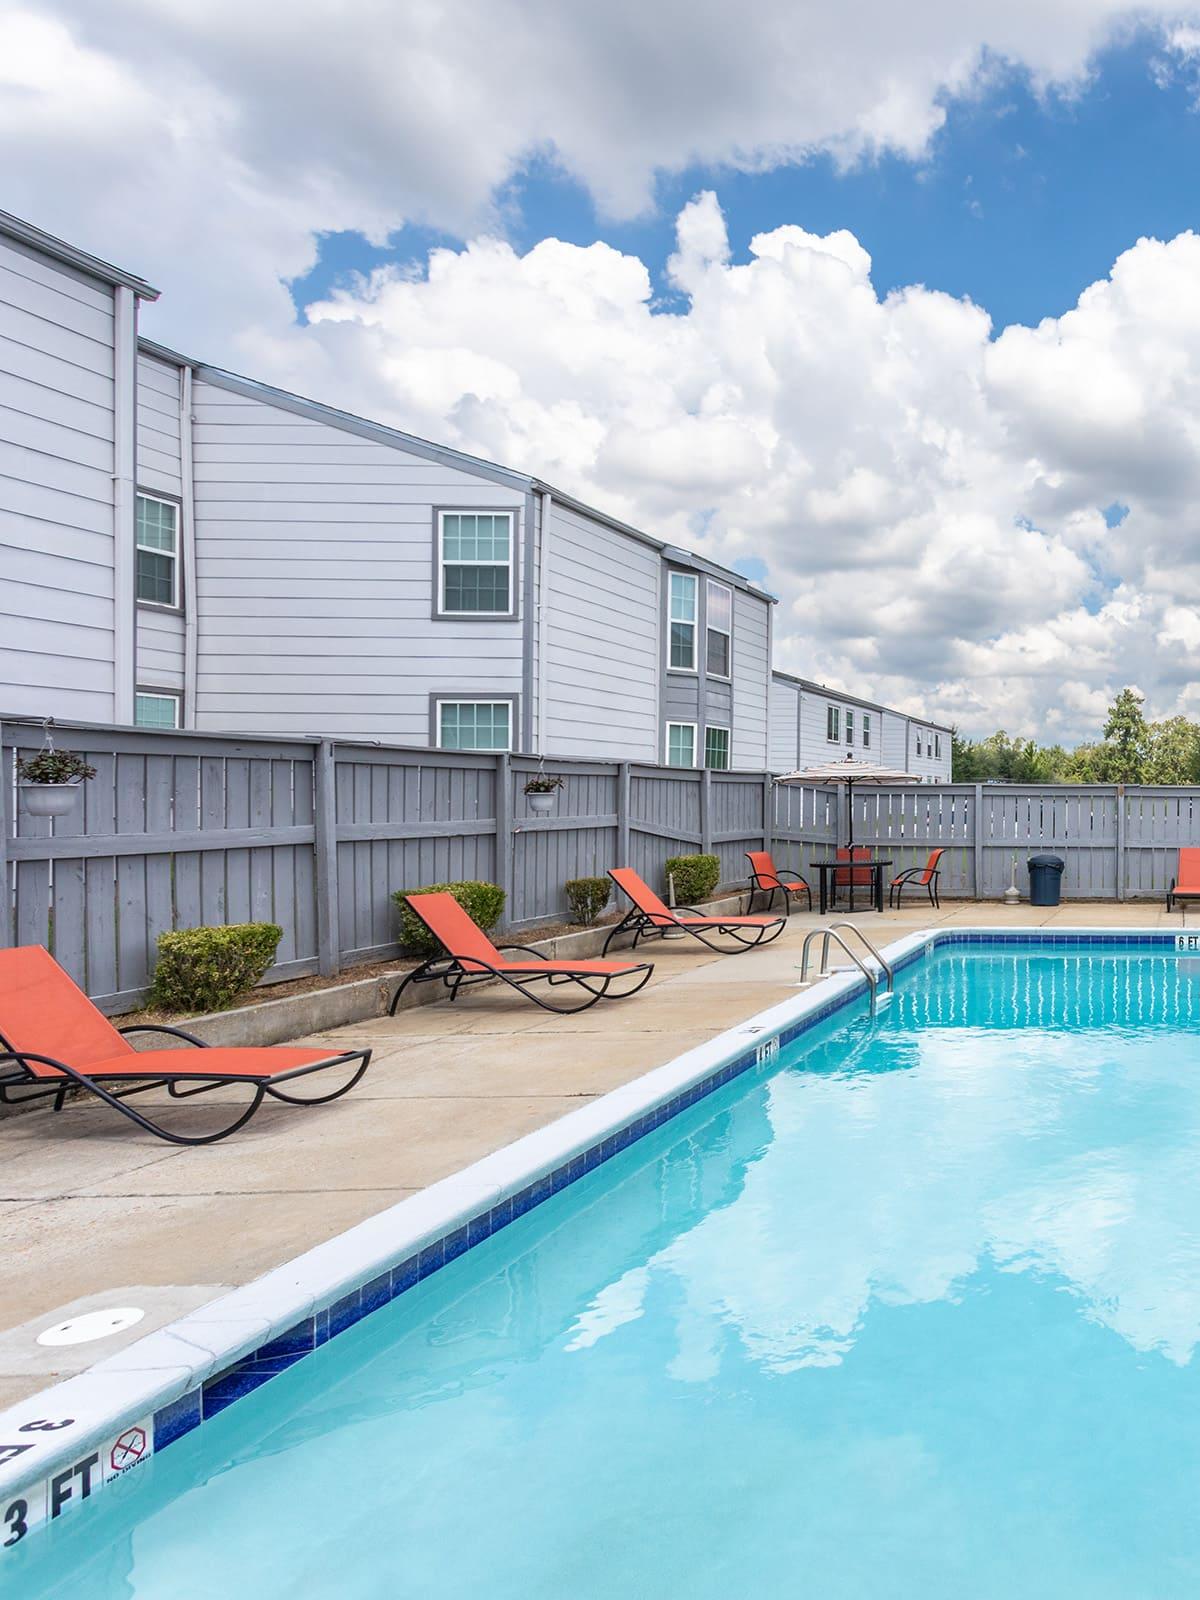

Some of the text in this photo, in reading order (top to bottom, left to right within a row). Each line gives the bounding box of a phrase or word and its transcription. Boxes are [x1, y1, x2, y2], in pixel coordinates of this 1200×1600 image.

[3, 1451, 100, 1548] 3 FT
[106, 1472, 119, 1484] NO
